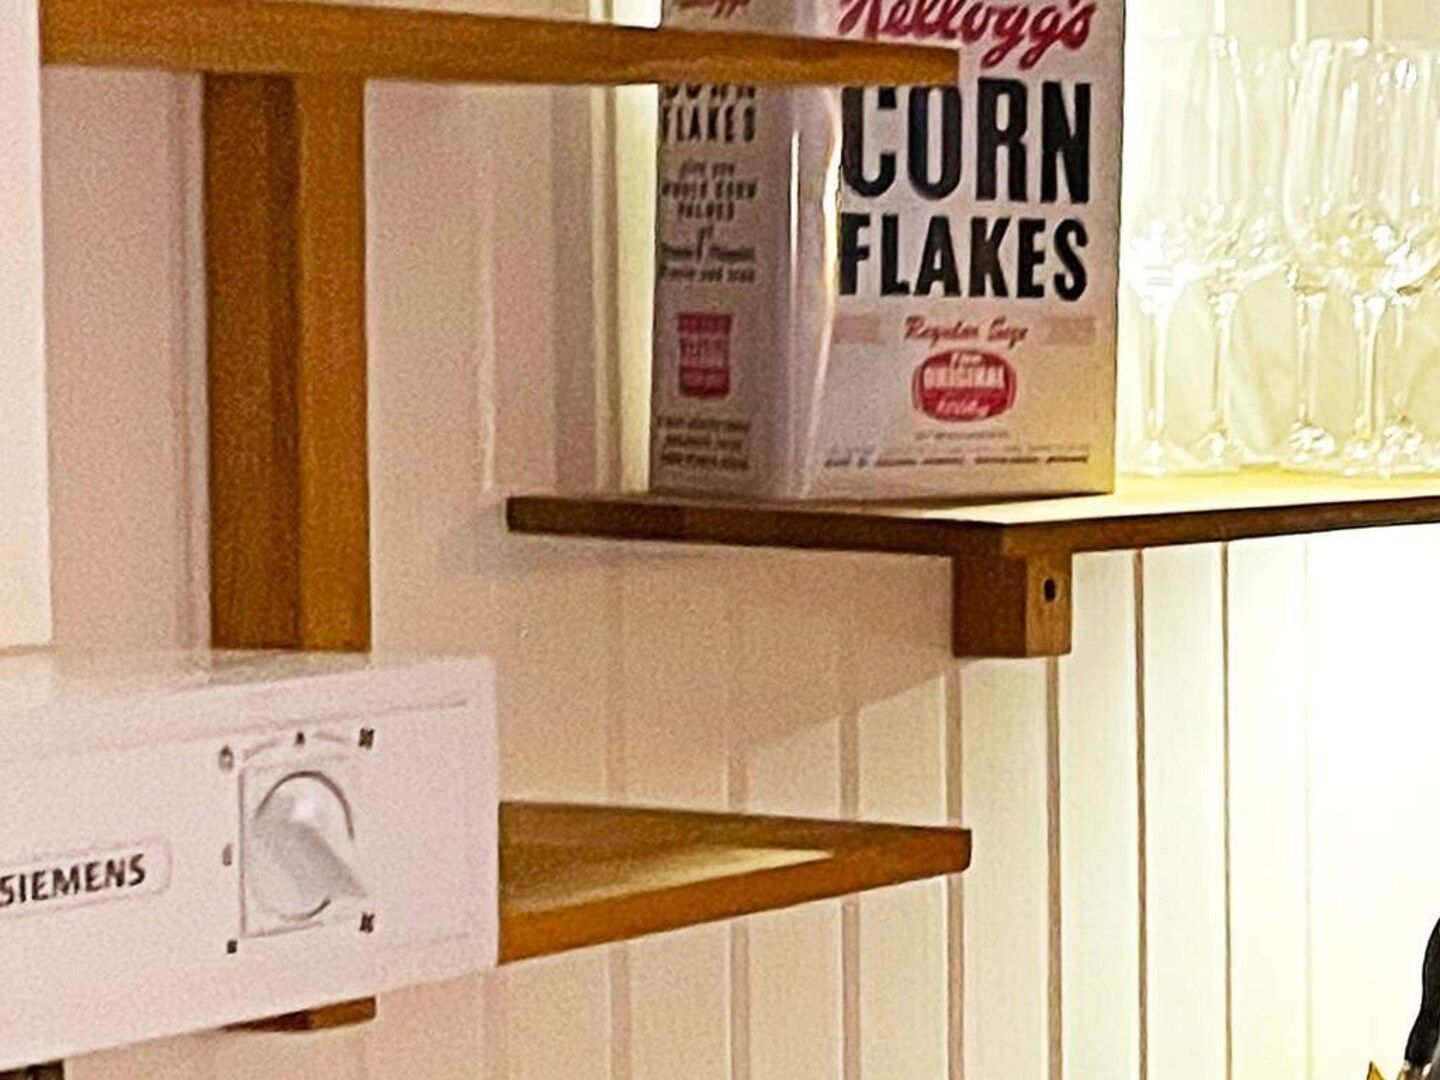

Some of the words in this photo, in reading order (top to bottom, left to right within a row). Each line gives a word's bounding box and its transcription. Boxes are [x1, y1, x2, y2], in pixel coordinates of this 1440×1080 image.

[840, 77, 1091, 205] CORN
[838, 212, 1090, 301] FLAKES
[904, 315, 980, 347] Regular
[0, 853, 146, 909] SIEMENS
